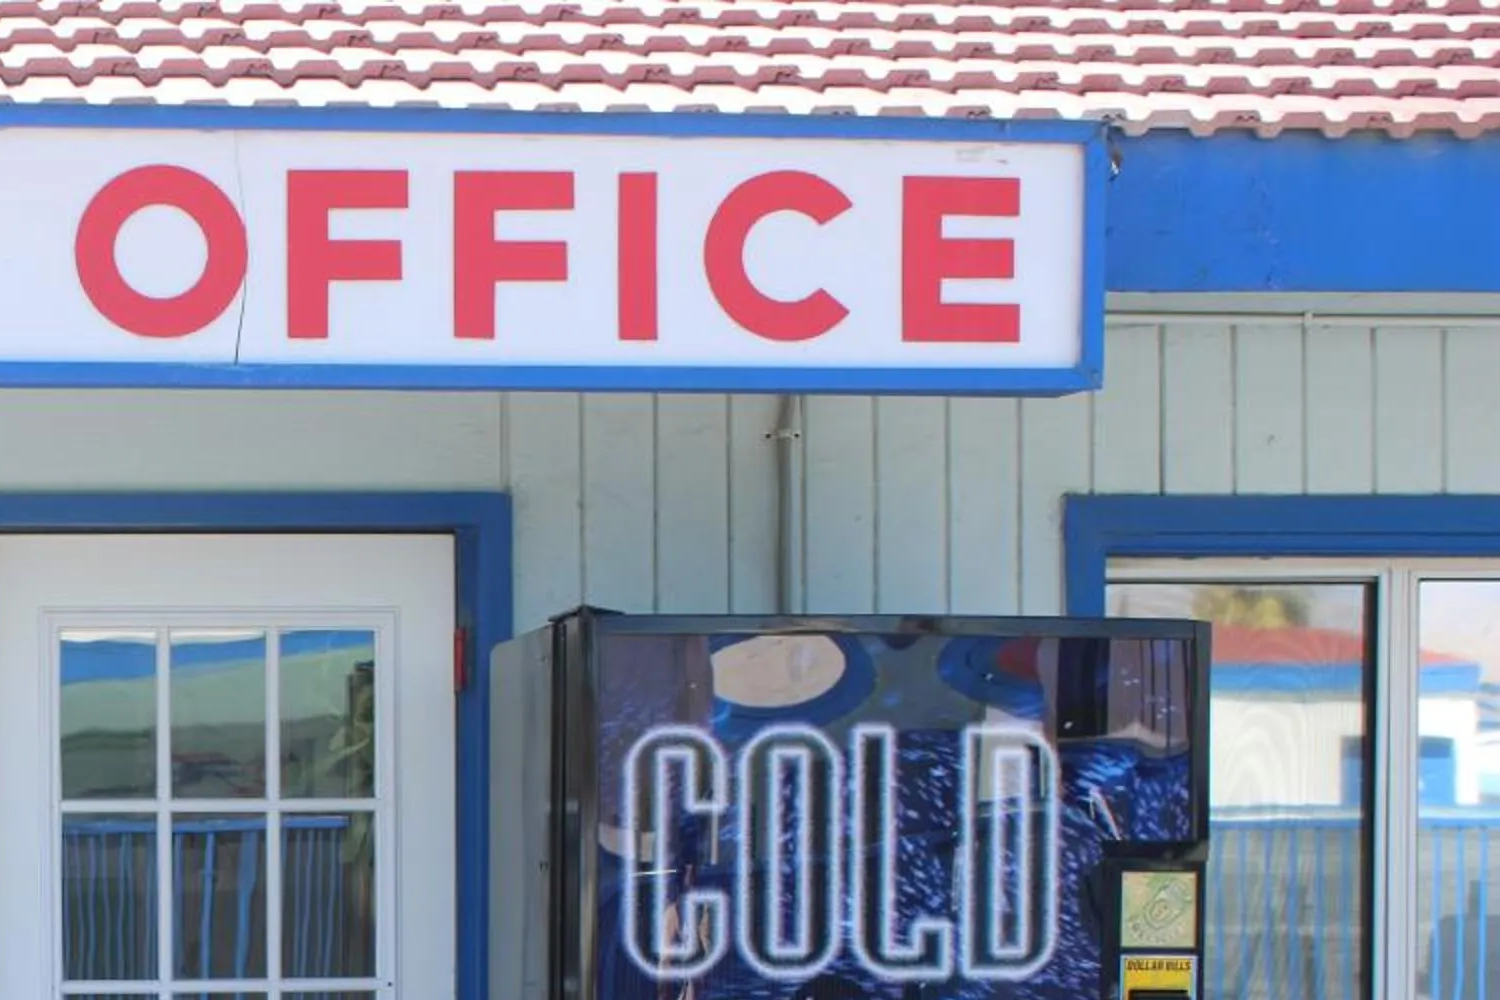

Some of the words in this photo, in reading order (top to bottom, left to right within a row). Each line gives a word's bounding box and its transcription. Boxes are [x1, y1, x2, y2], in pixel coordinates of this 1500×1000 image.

[74, 162, 1021, 344] OFFICE
[623, 722, 1063, 979] COLD
[1127, 960, 1163, 971] DOLLAR
